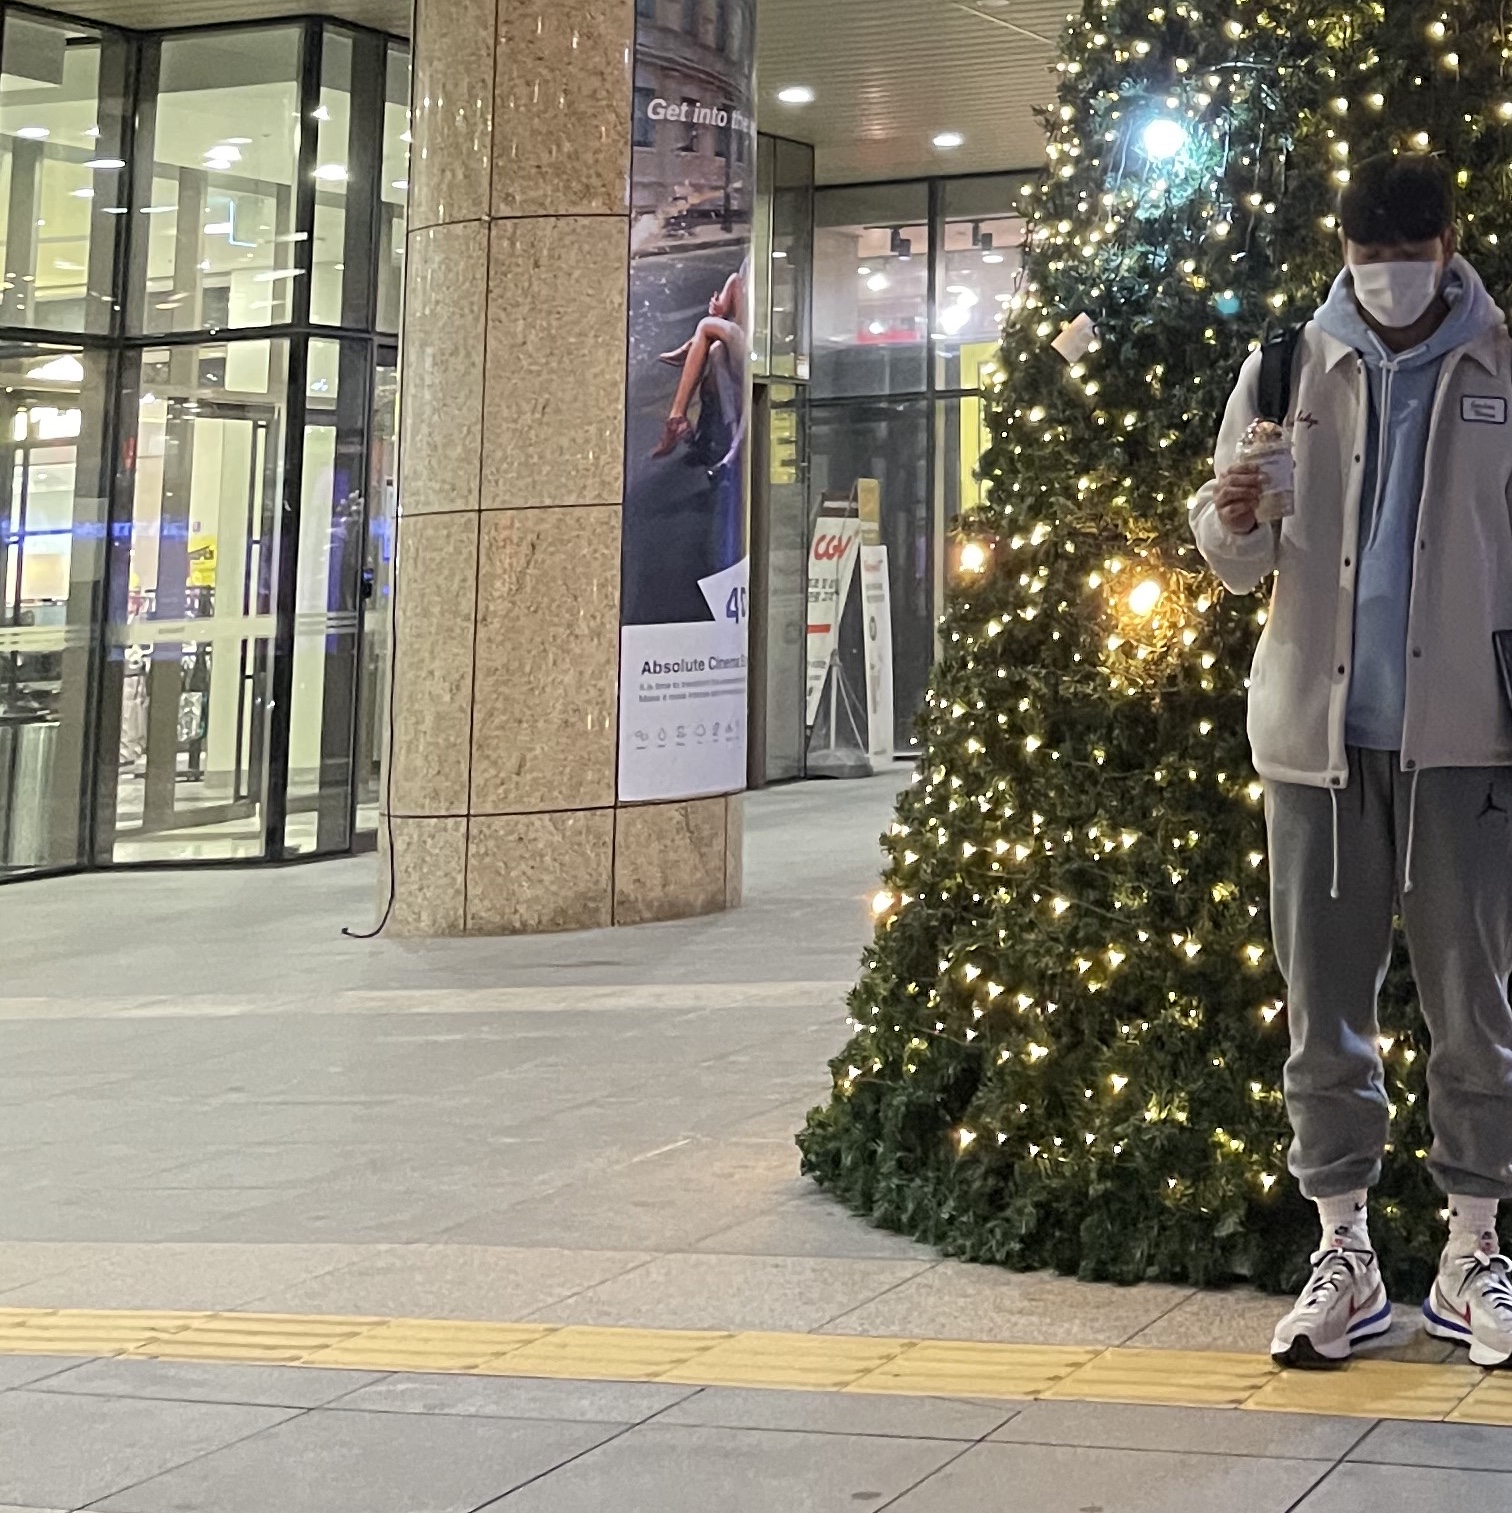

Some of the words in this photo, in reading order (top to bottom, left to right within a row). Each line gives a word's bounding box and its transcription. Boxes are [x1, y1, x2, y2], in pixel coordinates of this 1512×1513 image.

[647, 98, 689, 121] Get
[692, 102, 728, 127] into
[813, 534, 853, 561] CGV
[641, 658, 705, 676] Absolute
